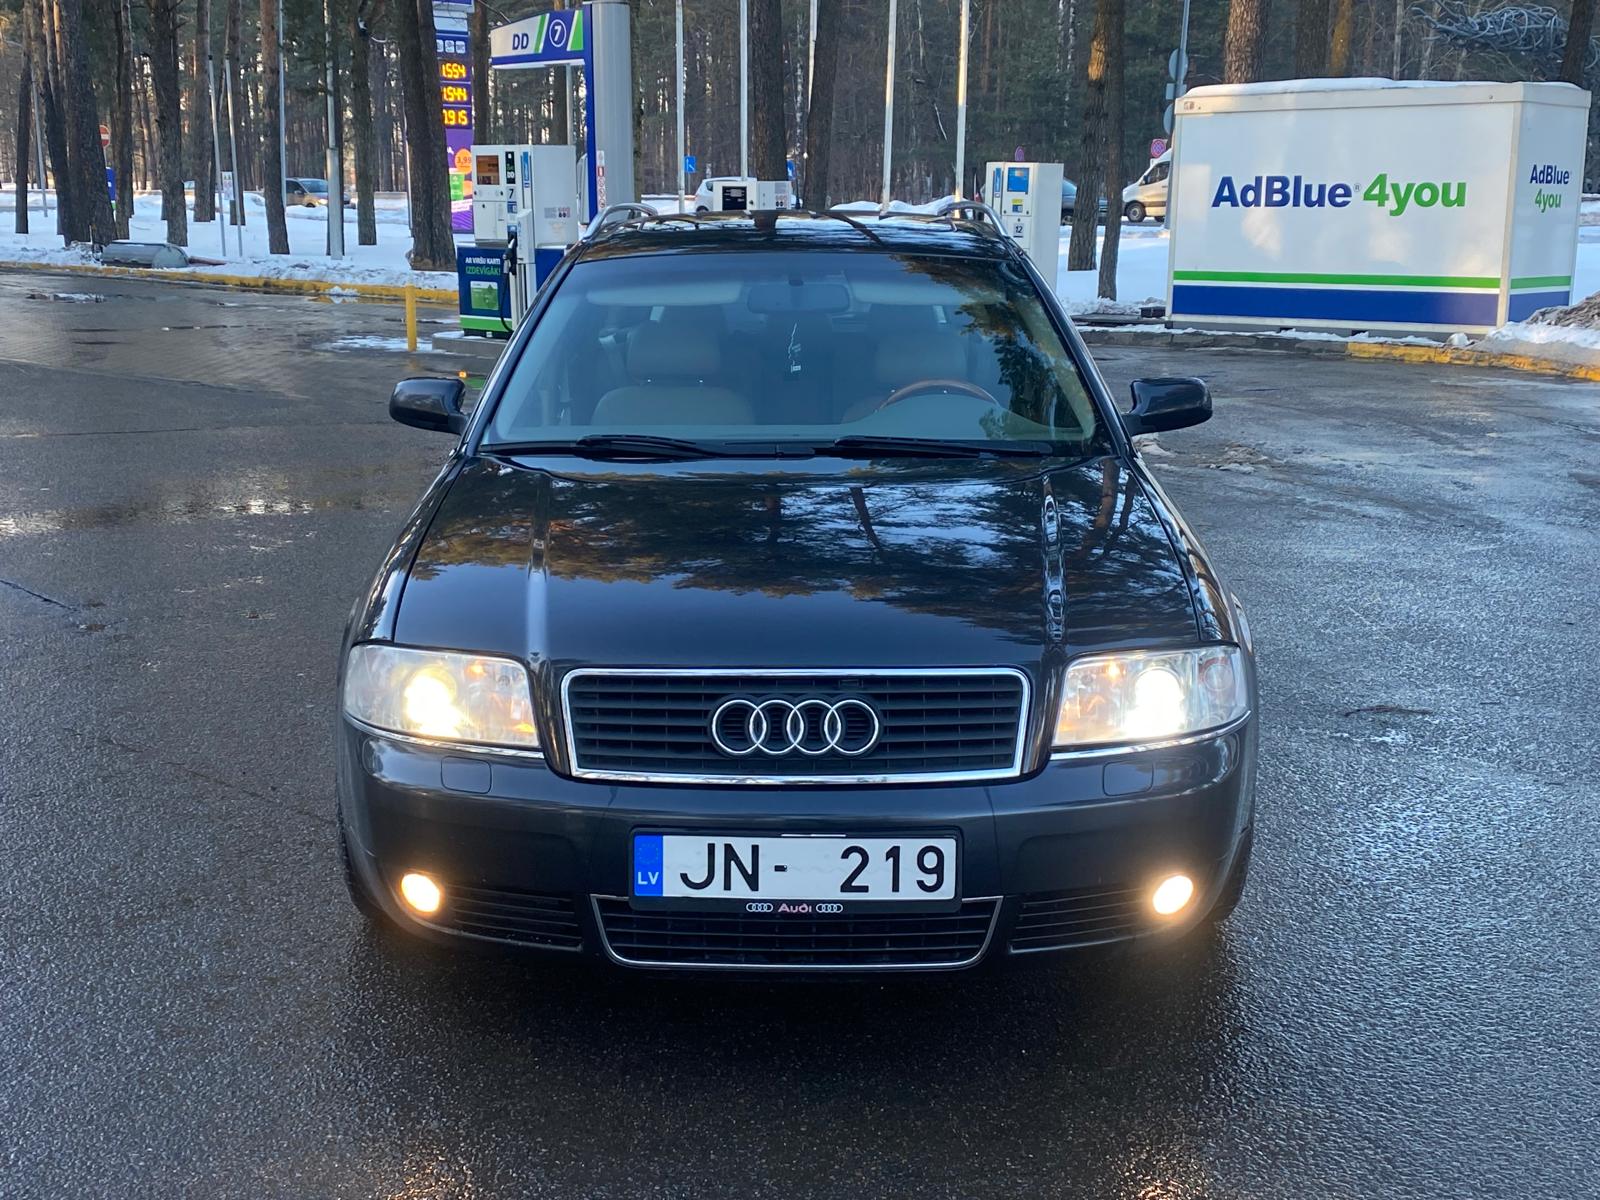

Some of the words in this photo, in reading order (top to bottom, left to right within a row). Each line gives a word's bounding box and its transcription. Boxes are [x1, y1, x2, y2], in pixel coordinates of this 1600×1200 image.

[512, 32, 529, 50] DD
[553, 25, 561, 41] 7
[1530, 164, 1570, 185] AdBlue
[508, 188, 514, 199] 7
[1363, 173, 1467, 217] 4you
[1535, 188, 1562, 213] 4you
[637, 871, 660, 886] LV
[839, 844, 946, 893] 219
[777, 903, 812, 913] Audi
